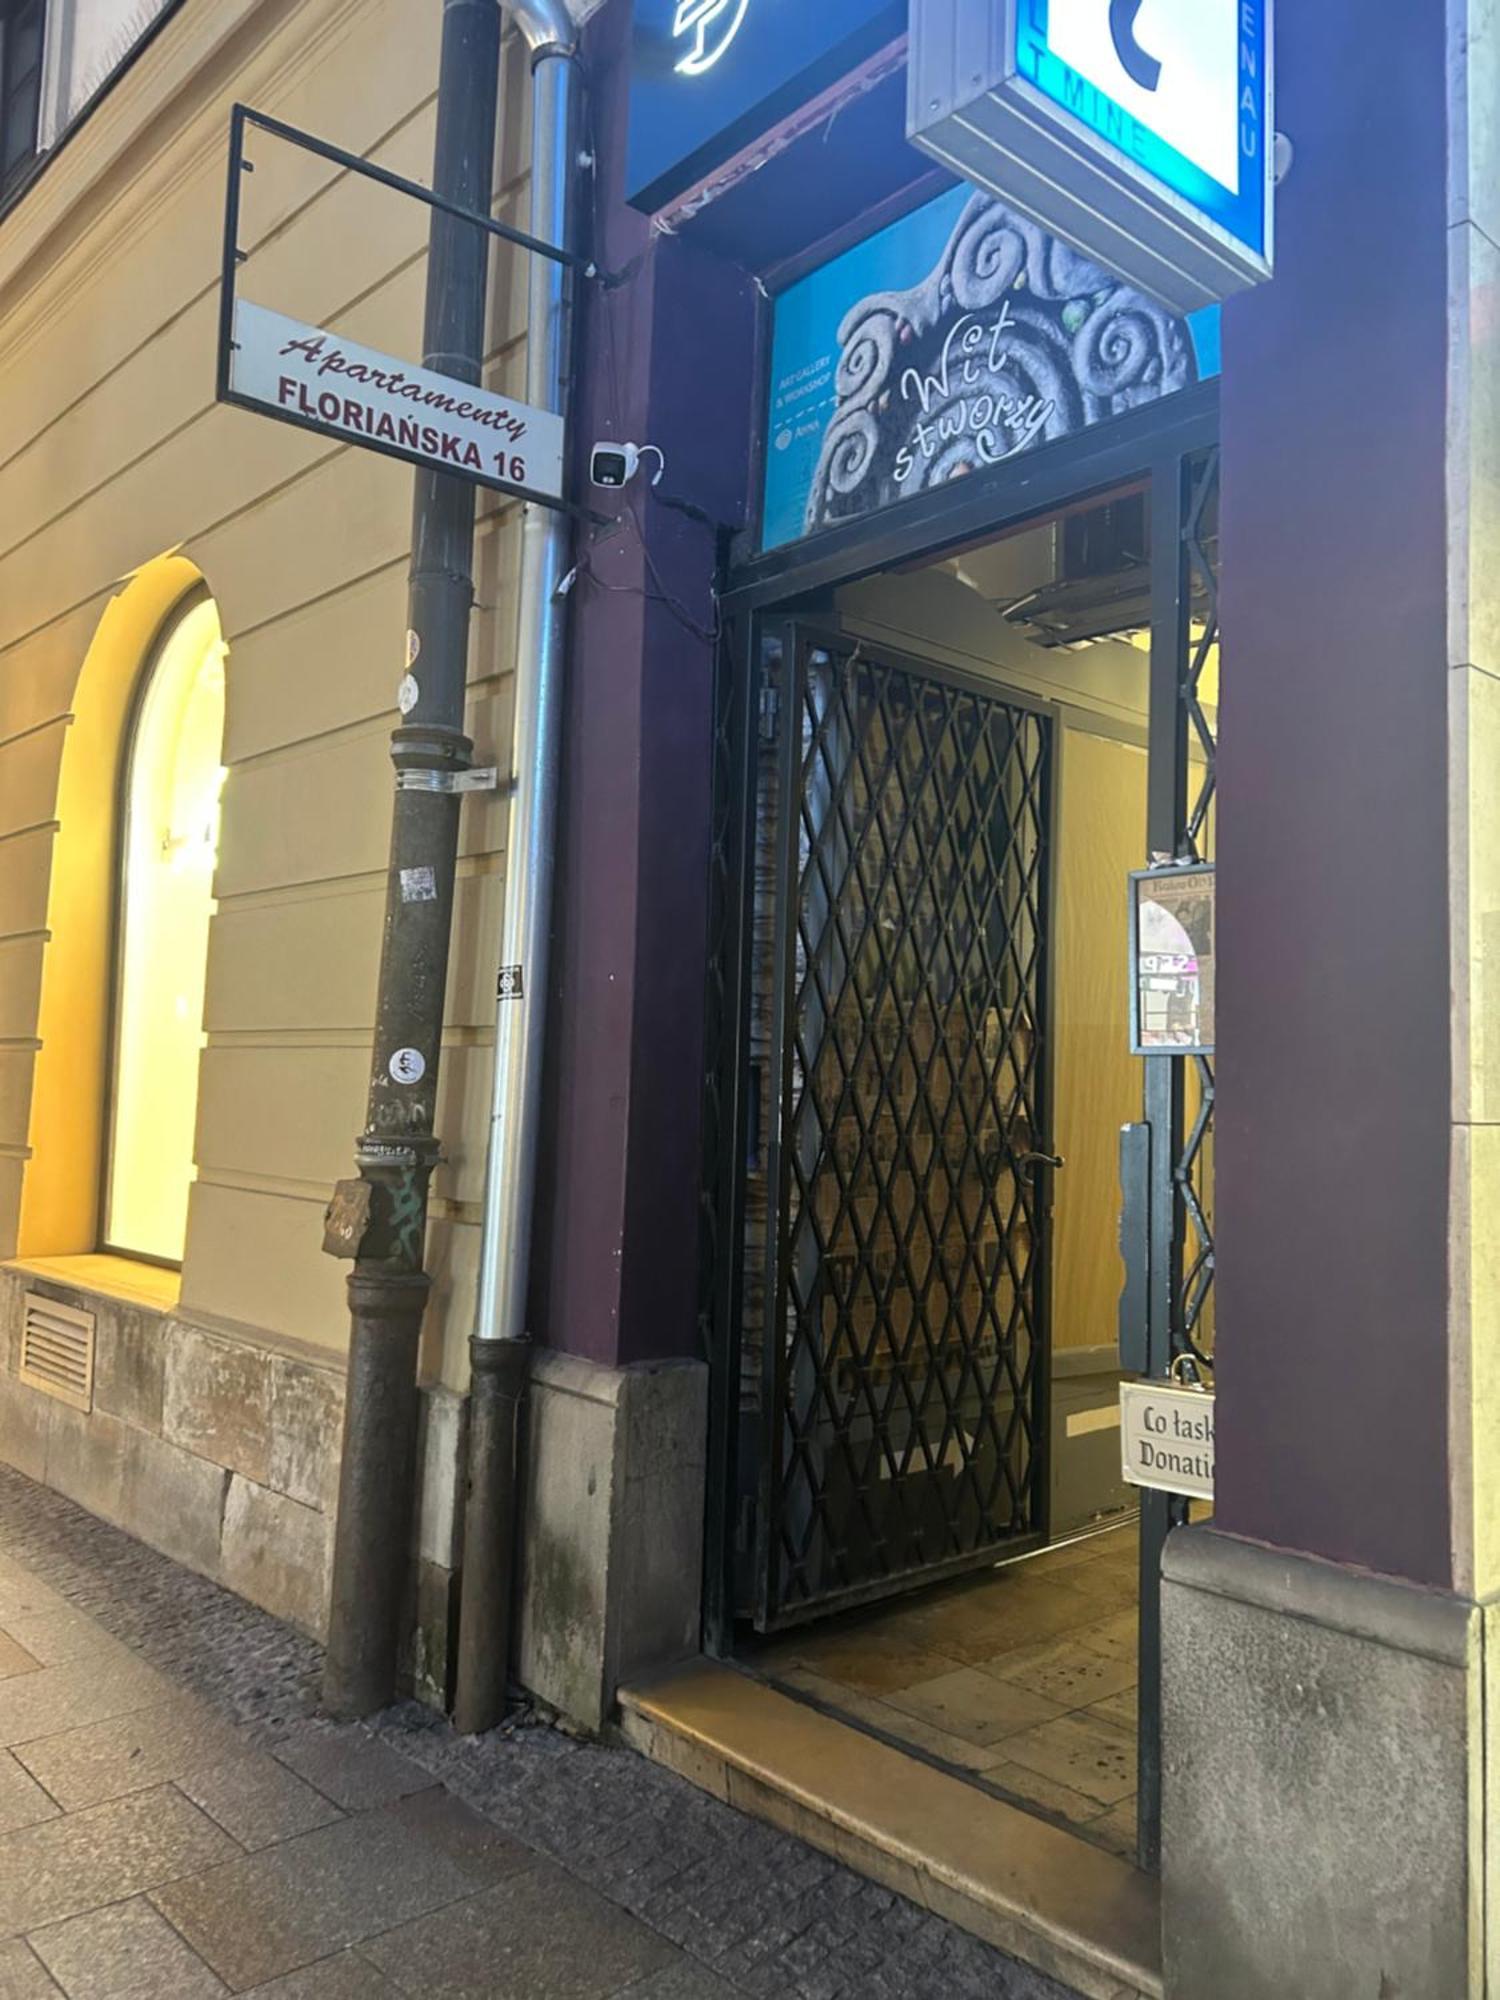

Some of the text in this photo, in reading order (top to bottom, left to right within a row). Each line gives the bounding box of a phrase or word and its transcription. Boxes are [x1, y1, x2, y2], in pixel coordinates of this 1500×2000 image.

[1063, 66, 1148, 160] MINE
[278, 335, 528, 442] Apartamenty
[901, 300, 1015, 414] Wit
[278, 376, 527, 483] FLORIAŃSKA 16
[892, 394, 1056, 483] stworzy
[1138, 1439, 1216, 1480] Donati
[1143, 1405, 1167, 1434] Co
